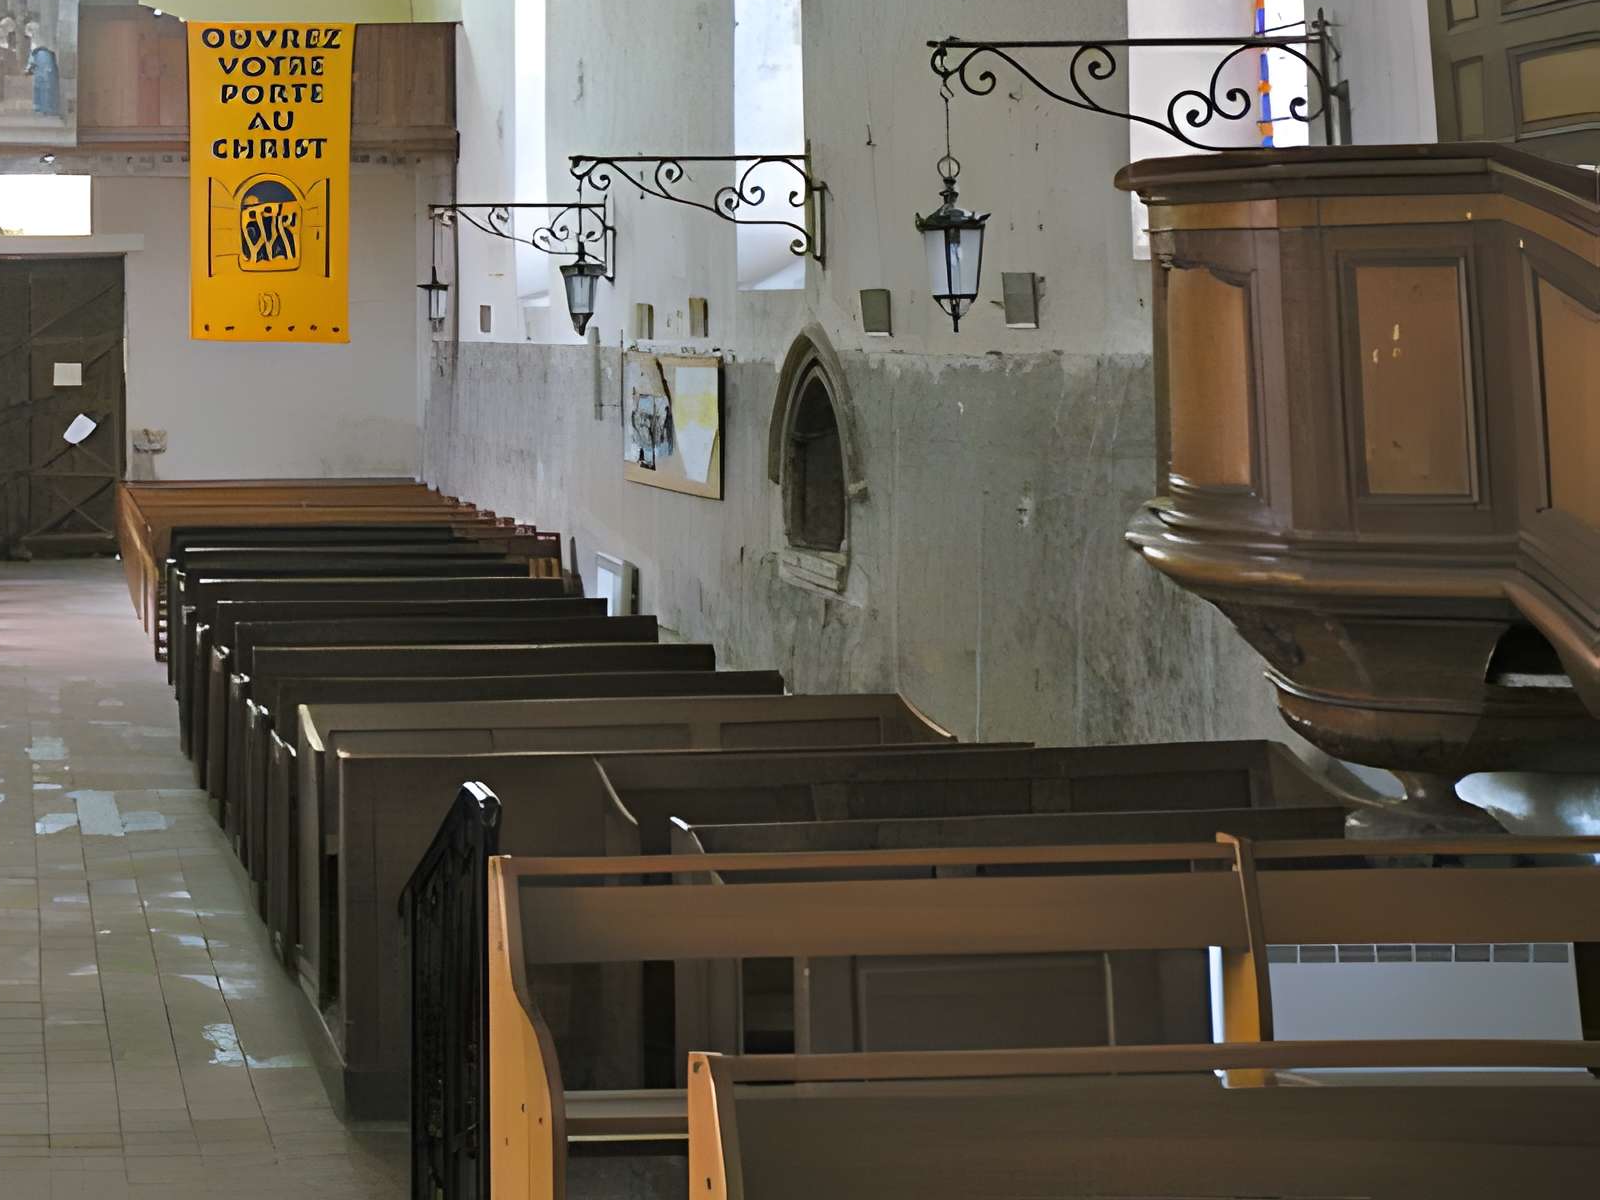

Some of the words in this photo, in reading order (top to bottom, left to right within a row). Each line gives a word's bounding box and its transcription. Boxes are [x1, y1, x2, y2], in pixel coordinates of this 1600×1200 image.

[202, 28, 342, 49] OUVREZ
[218, 56, 325, 77] VOTRE
[221, 84, 324, 104] PORTE
[248, 111, 294, 131] AU
[212, 138, 328, 159] CHRIST
